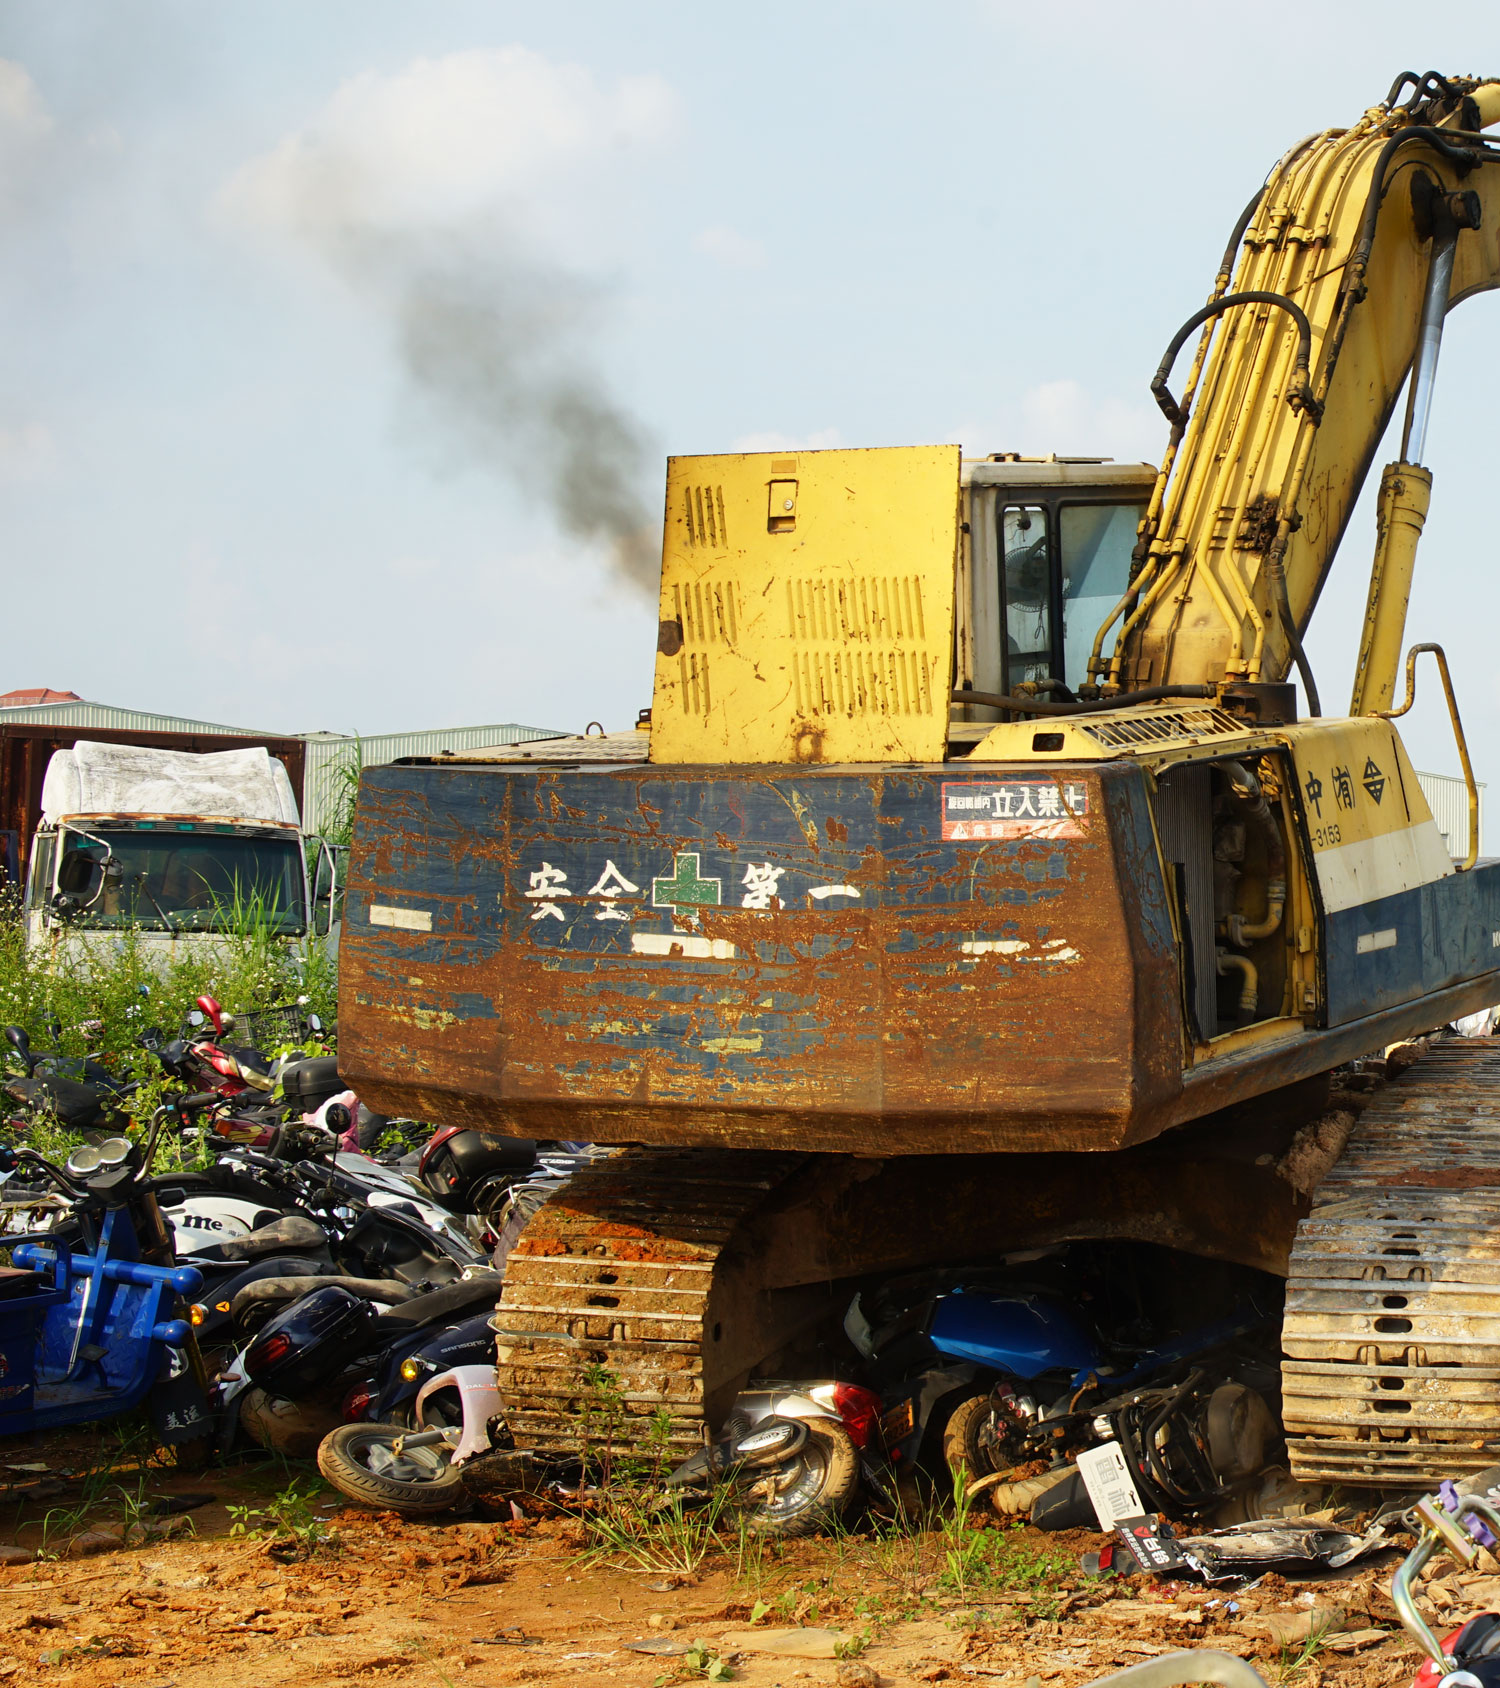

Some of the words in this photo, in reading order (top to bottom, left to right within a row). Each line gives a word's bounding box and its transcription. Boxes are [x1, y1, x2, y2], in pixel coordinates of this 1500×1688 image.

[992, 786, 1084, 818] 立入禁止
[182, 1214, 223, 1231] me
